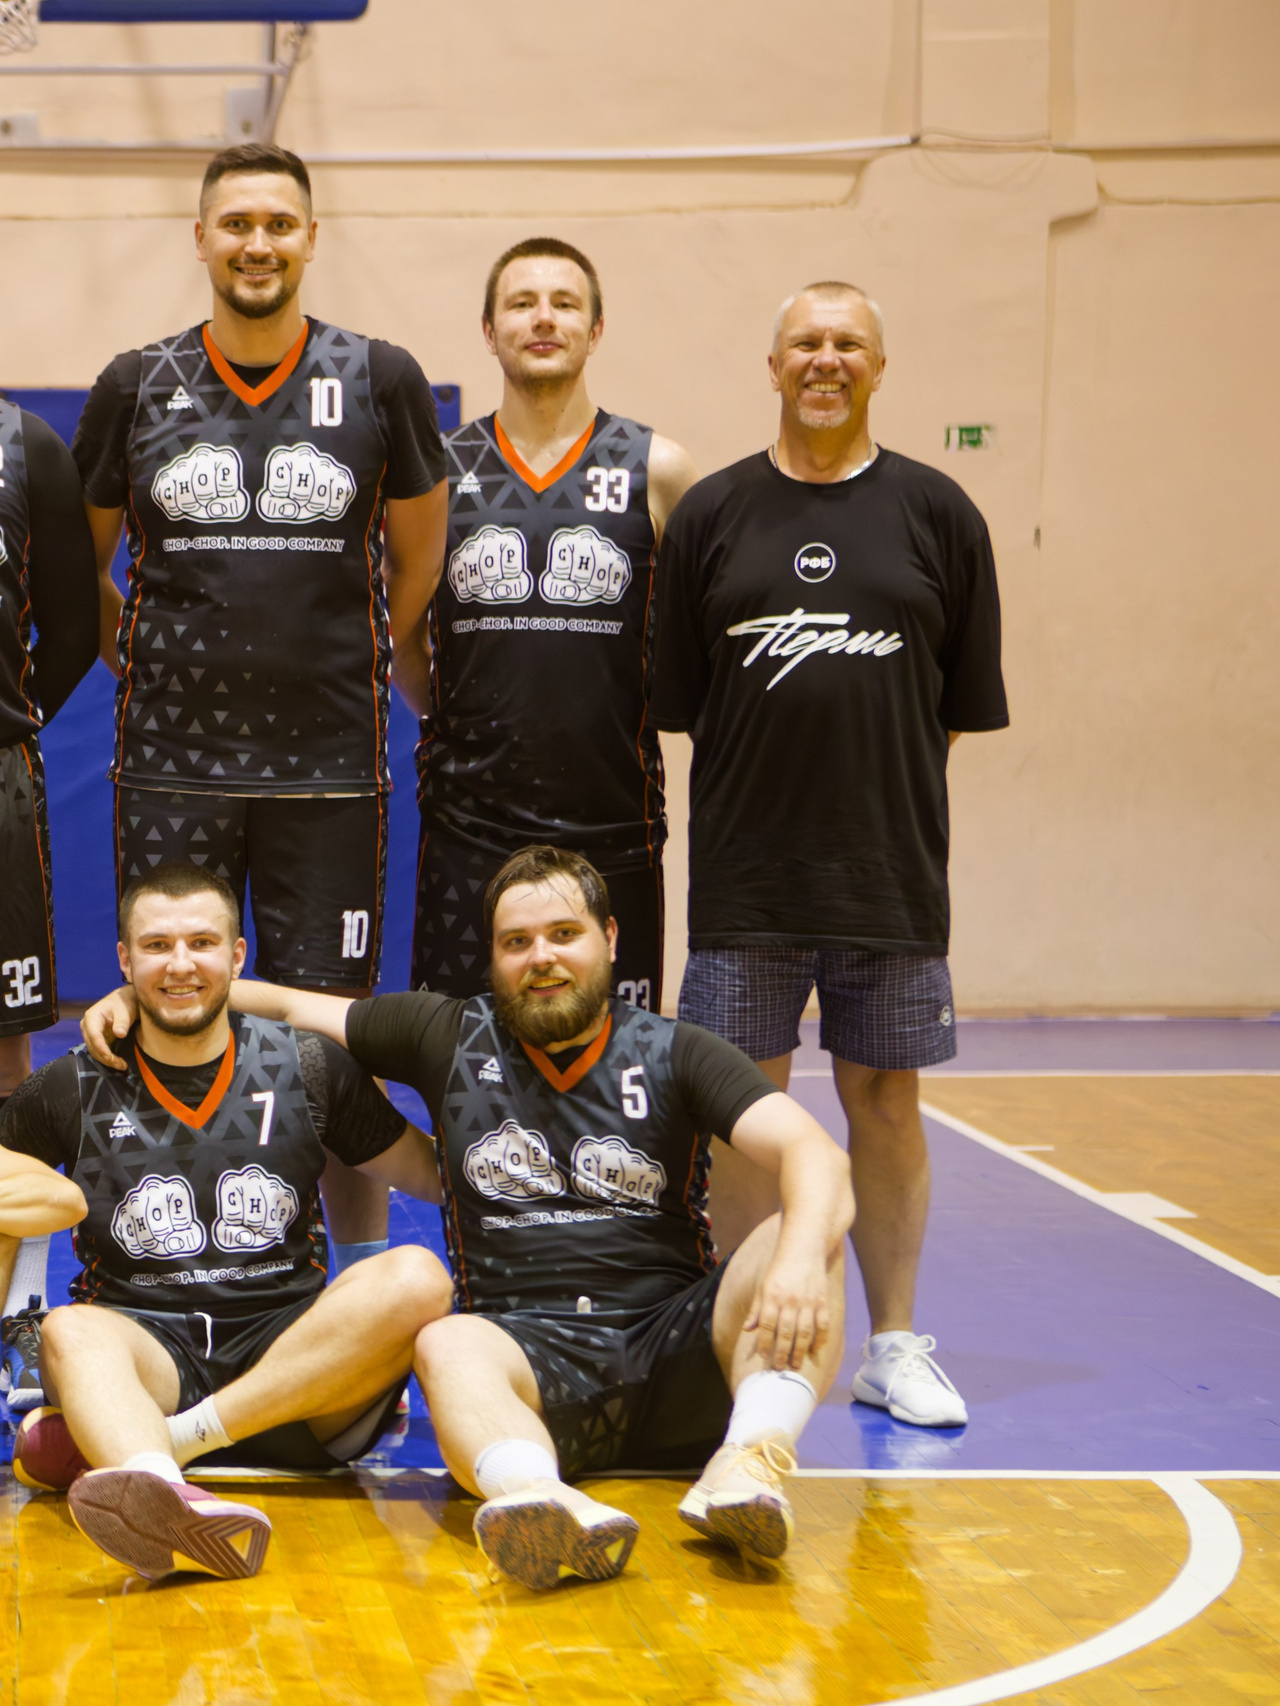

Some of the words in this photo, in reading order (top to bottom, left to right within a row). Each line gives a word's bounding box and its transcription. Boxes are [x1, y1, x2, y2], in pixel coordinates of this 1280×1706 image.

[309, 377, 343, 427] 10
[584, 466, 630, 513] 33
[231, 536, 246, 549] IN
[247, 536, 286, 550] GOOD
[287, 538, 344, 552] COMPANY
[799, 556, 831, 569] РФБ
[513, 617, 528, 630] IN
[529, 617, 567, 631] GOOD
[568, 619, 623, 634] COMPANY
[726, 607, 904, 691] Пермь
[341, 910, 369, 959] 10
[2, 955, 42, 1008] 32
[621, 1065, 648, 1120] 5
[251, 1091, 275, 1146] 7
[554, 1210, 570, 1224] IN
[571, 1207, 614, 1222] GOOD
[194, 1269, 208, 1283] IN
[209, 1267, 245, 1282] GOOD
